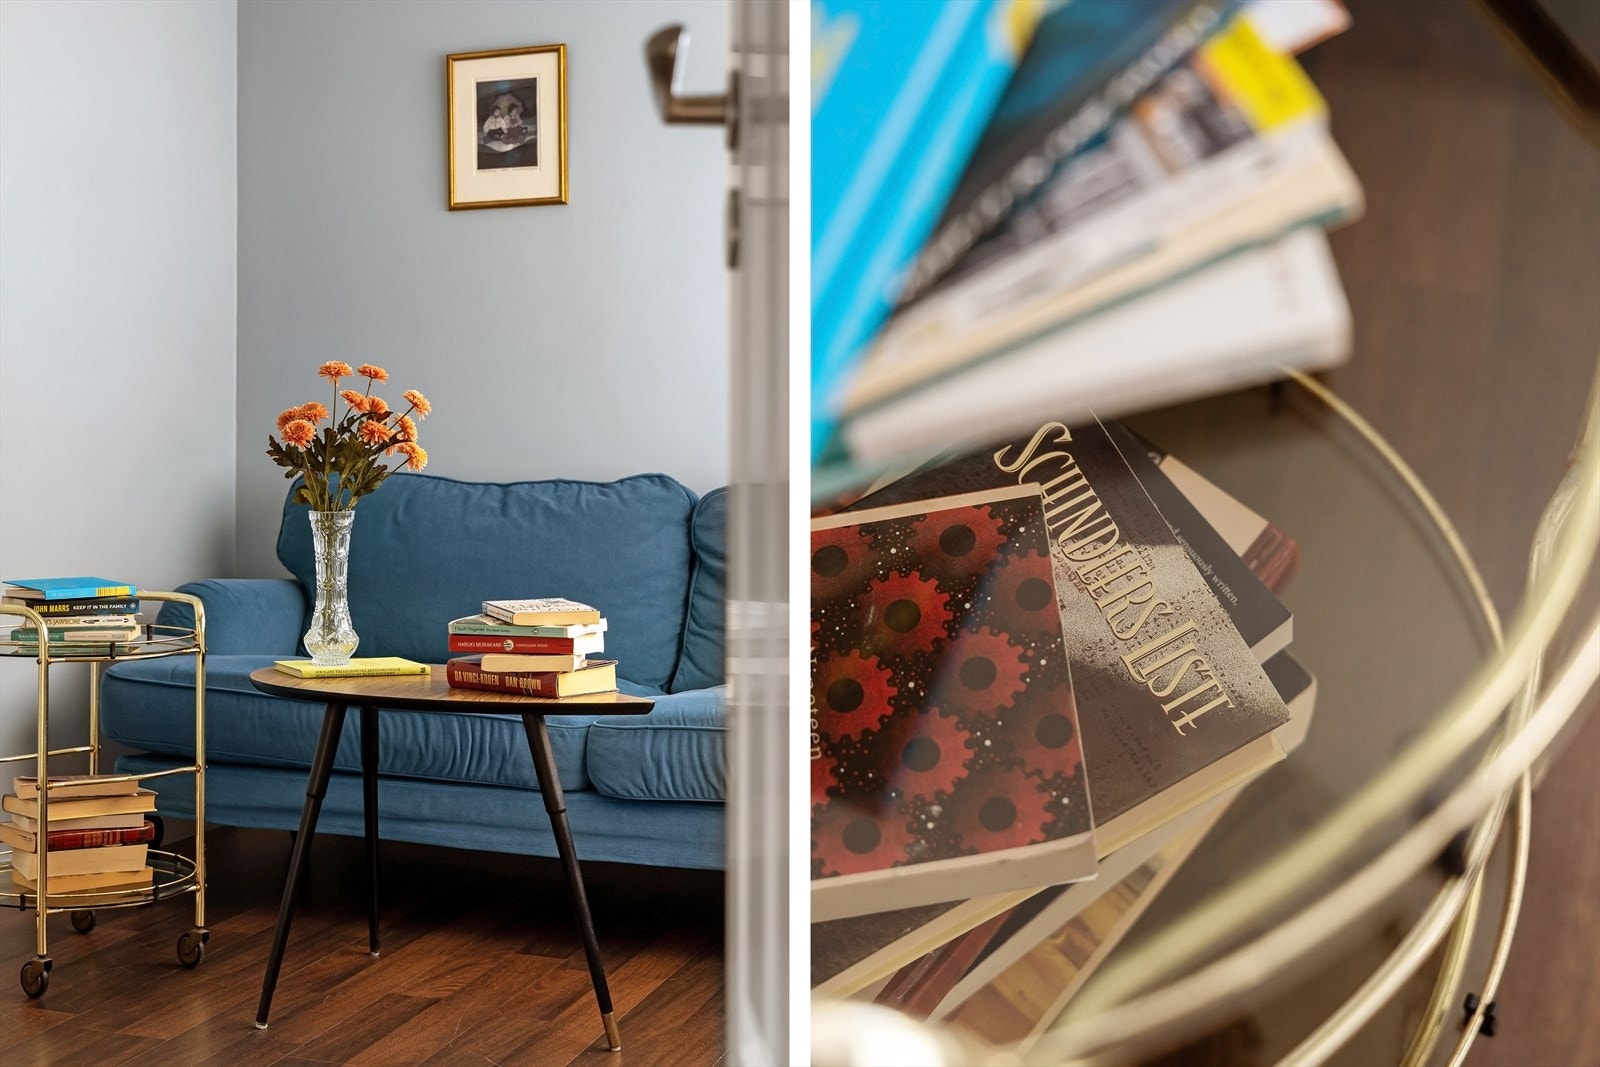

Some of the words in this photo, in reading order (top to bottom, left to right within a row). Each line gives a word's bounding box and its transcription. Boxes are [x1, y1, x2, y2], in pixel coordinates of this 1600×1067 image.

[993, 421, 1174, 641] SCHINDLERS
[1120, 616, 1236, 737] LISTE
[1212, 574, 1239, 606] written.
[34, 605, 48, 613] JOHN
[49, 604, 70, 612] MARRS
[454, 670, 462, 682] DA
[505, 675, 518, 688] DAN
[520, 677, 542, 691] BROWN
